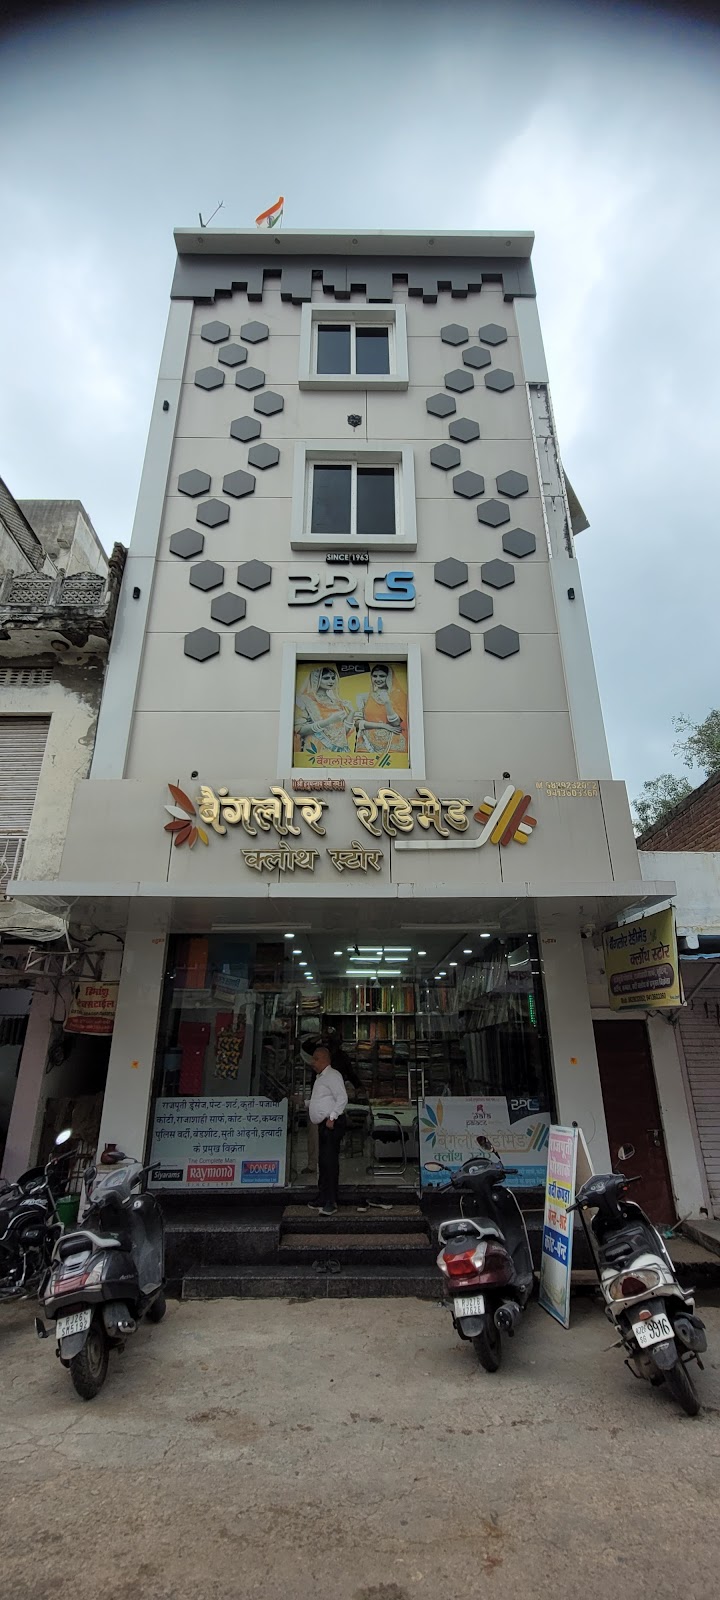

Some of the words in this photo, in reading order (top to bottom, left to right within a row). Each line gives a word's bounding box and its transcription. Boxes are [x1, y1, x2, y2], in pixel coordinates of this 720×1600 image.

[326, 553, 349, 561] SINCE
[351, 553, 369, 561] 1963
[318, 616, 384, 633] DEOLI
[196, 785, 329, 836] बैंगलोर
[326, 839, 384, 872] स्टोर
[651, 941, 670, 961] स्टोर
[153, 1171, 181, 1180] Siyarams
[190, 1166, 233, 1181] Raymond
[249, 1163, 276, 1174] DONEAR
[647, 1318, 671, 1339] 9916
